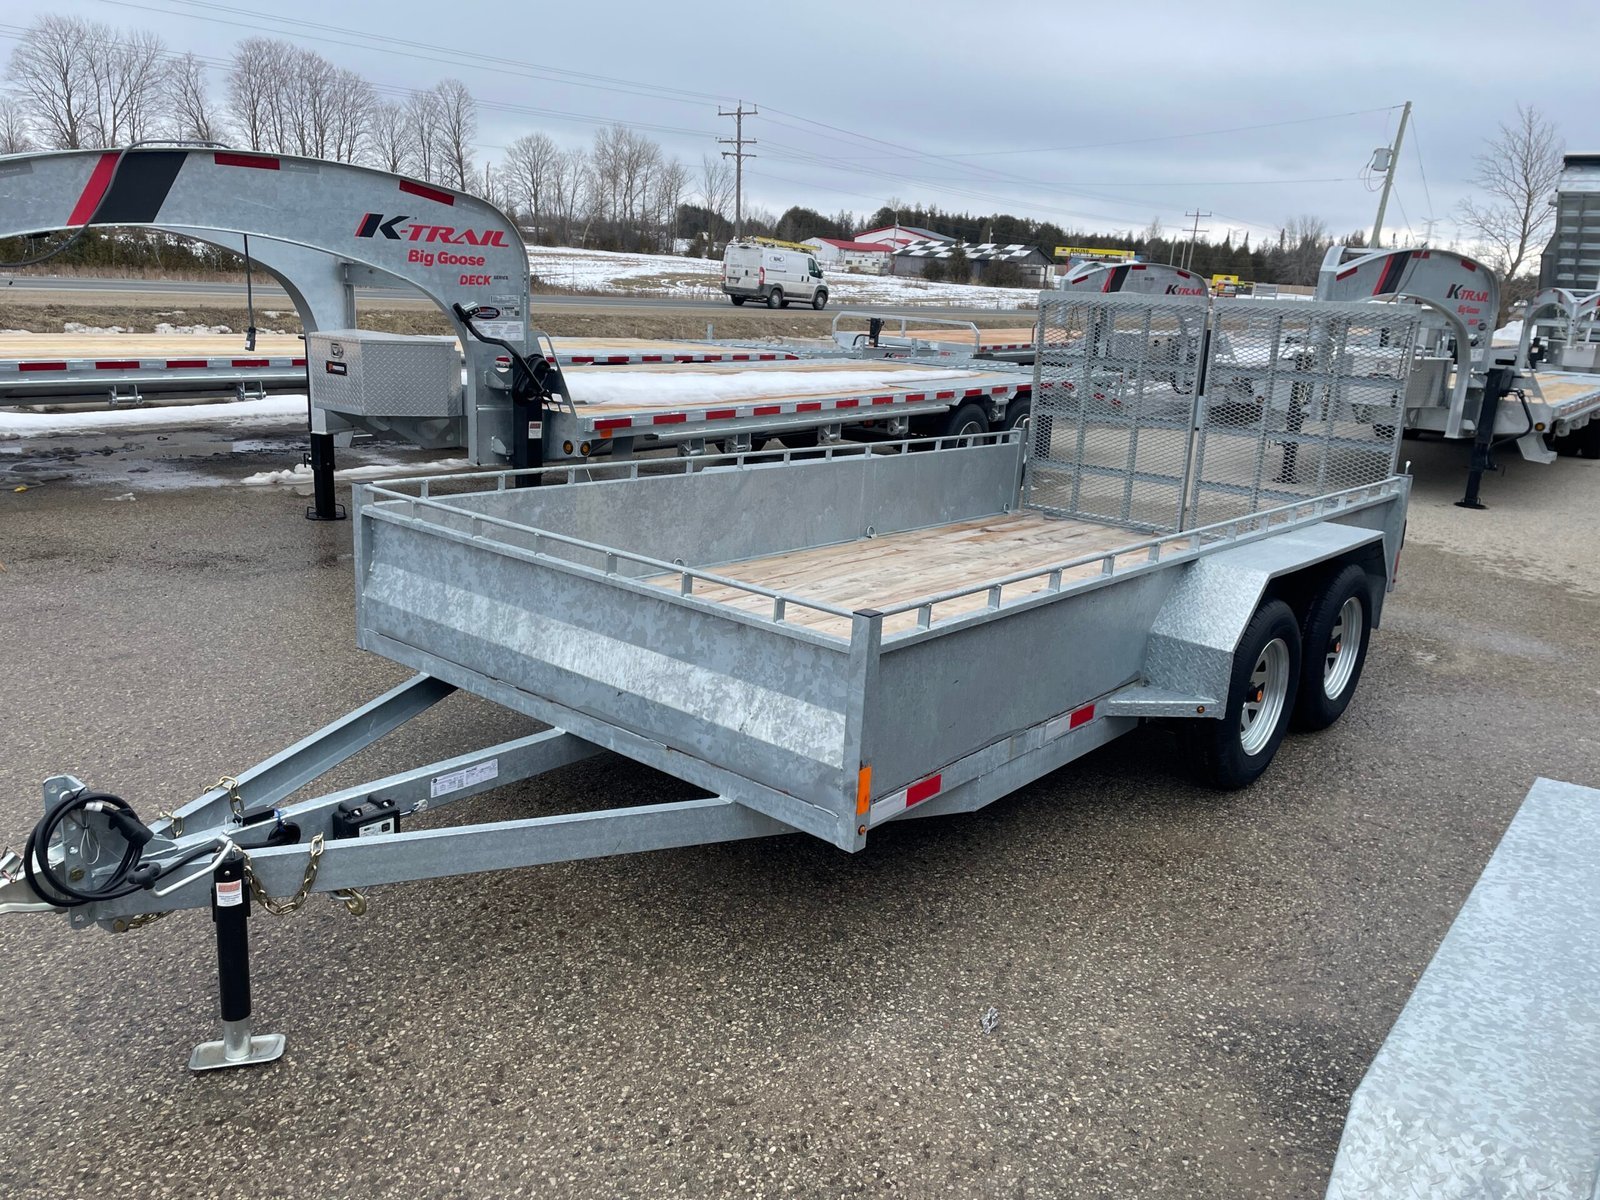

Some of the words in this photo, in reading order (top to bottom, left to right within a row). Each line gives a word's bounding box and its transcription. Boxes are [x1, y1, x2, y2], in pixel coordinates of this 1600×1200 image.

[355, 213, 509, 247] K-TRAIL
[408, 249, 435, 267] Big
[437, 251, 486, 267] Goose
[460, 275, 491, 285] DECK
